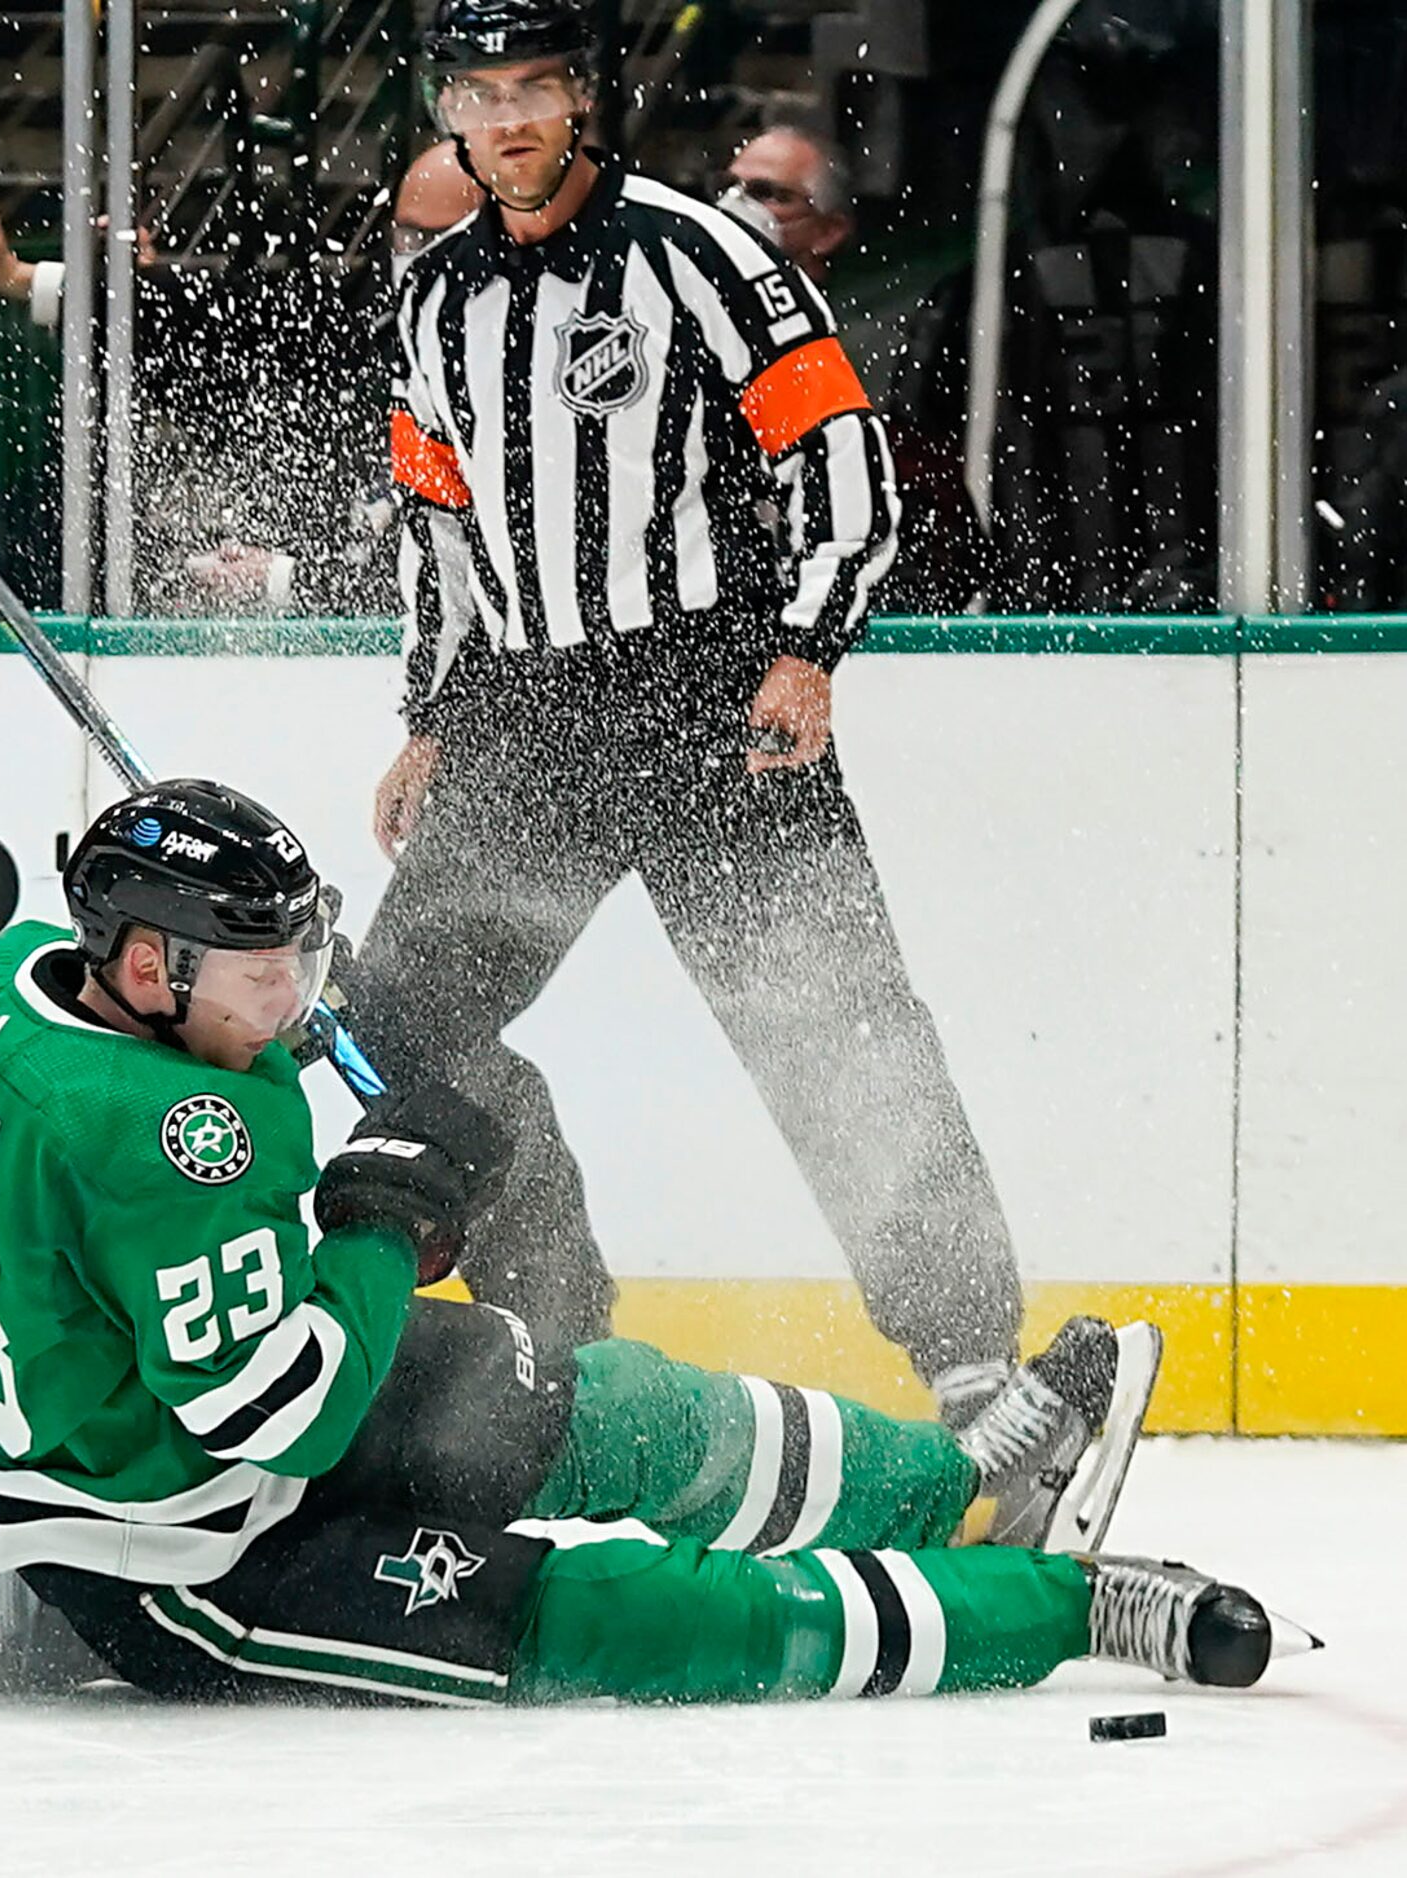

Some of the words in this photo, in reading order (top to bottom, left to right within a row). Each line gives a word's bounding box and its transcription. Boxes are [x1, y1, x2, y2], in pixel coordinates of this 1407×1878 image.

[754, 273, 796, 318] 15
[573, 338, 627, 393] NHL
[160, 830, 219, 863] AT&T
[168, 1100, 242, 1137] DALLAS
[178, 1149, 247, 1178] STARS
[156, 1227, 284, 1363] 23
